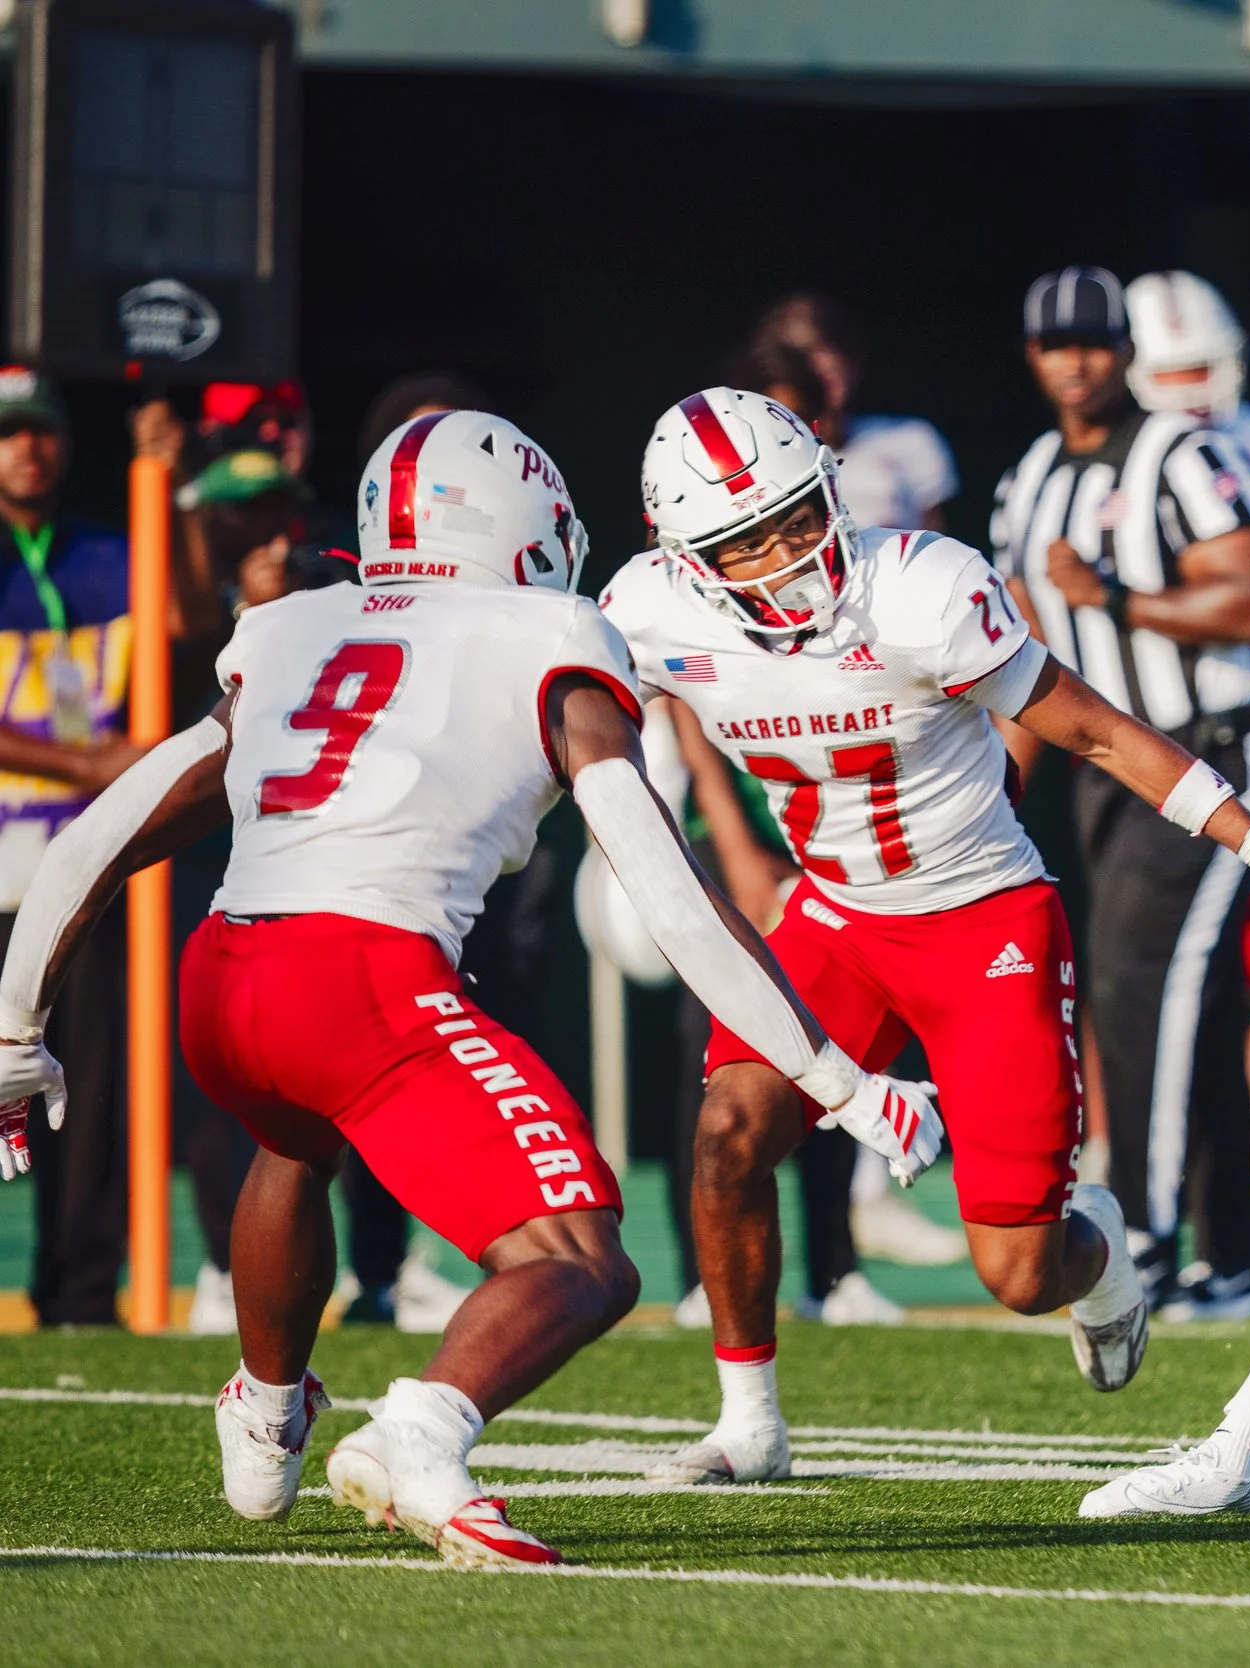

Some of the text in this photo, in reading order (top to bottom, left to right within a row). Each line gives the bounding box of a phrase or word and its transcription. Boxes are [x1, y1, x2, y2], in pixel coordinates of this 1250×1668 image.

[514, 442, 571, 503] Pio
[364, 562, 459, 579] SACRED HEART
[361, 594, 416, 614] SHU
[968, 573, 1016, 647] 27
[837, 661, 886, 671] adidas
[254, 638, 412, 820] 9
[717, 703, 894, 740] SACRED HEART
[740, 737, 920, 886] 27
[985, 961, 1035, 978] adidas
[414, 991, 596, 1208] PIONEERS
